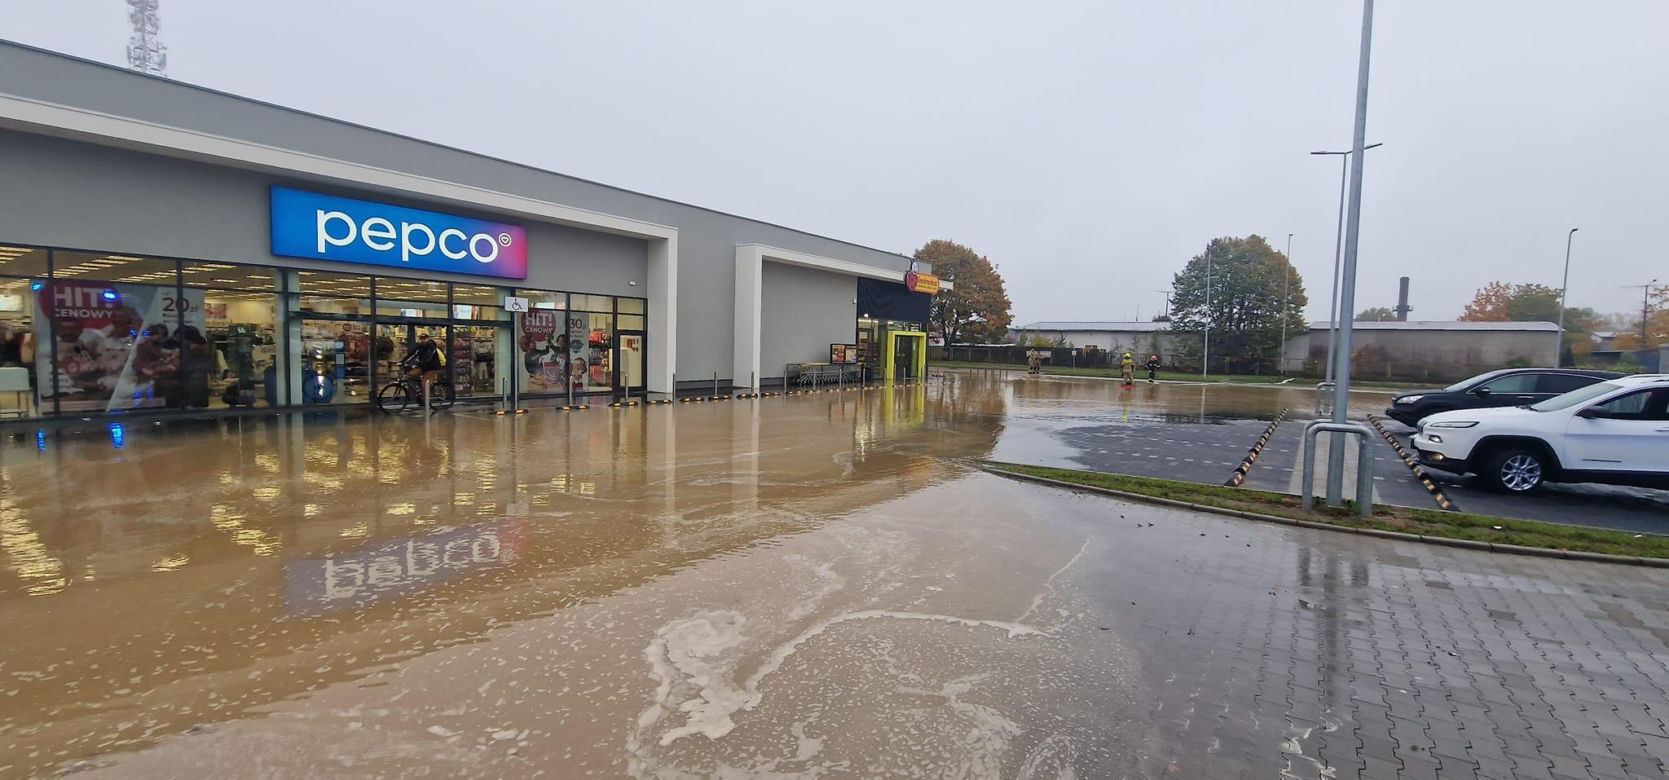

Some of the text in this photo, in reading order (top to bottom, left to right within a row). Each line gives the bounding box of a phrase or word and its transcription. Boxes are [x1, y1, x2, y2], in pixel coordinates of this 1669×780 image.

[316, 209, 499, 263] pepco
[162, 297, 190, 312] 20
[525, 312, 553, 326] HIT!
[569, 318, 582, 329] 30
